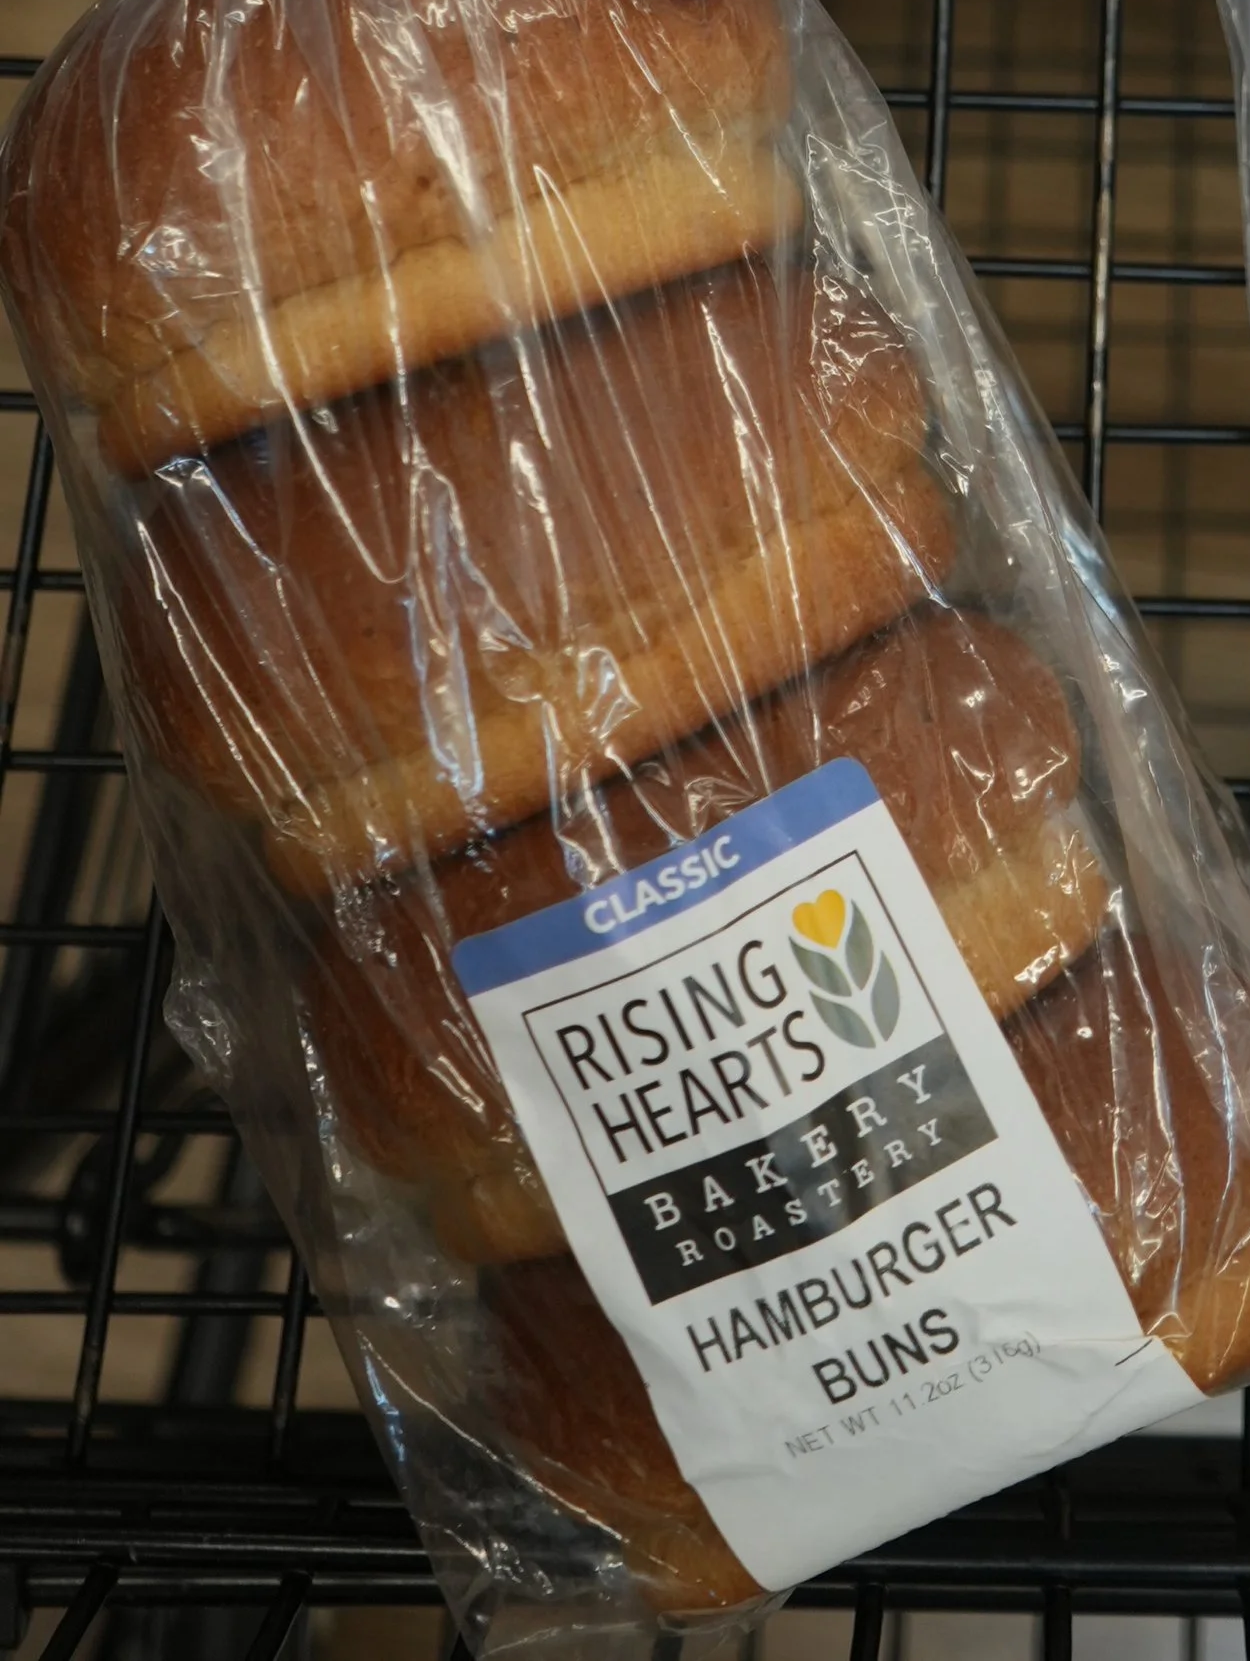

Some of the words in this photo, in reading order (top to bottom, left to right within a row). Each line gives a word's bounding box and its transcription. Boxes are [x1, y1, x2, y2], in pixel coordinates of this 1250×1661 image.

[584, 835, 741, 934] CLASSIC
[556, 940, 788, 1091] RISING
[592, 1010, 826, 1164] HEARTS
[643, 1065, 933, 1231] BAKERY
[675, 1119, 944, 1266] ROASTERY
[685, 1181, 1018, 1372] HAMBURGER
[785, 1425, 836, 1458] NET
[840, 1405, 880, 1436] WT
[890, 1373, 965, 1416] 11.2oz
[812, 1307, 961, 1404] BUNS
